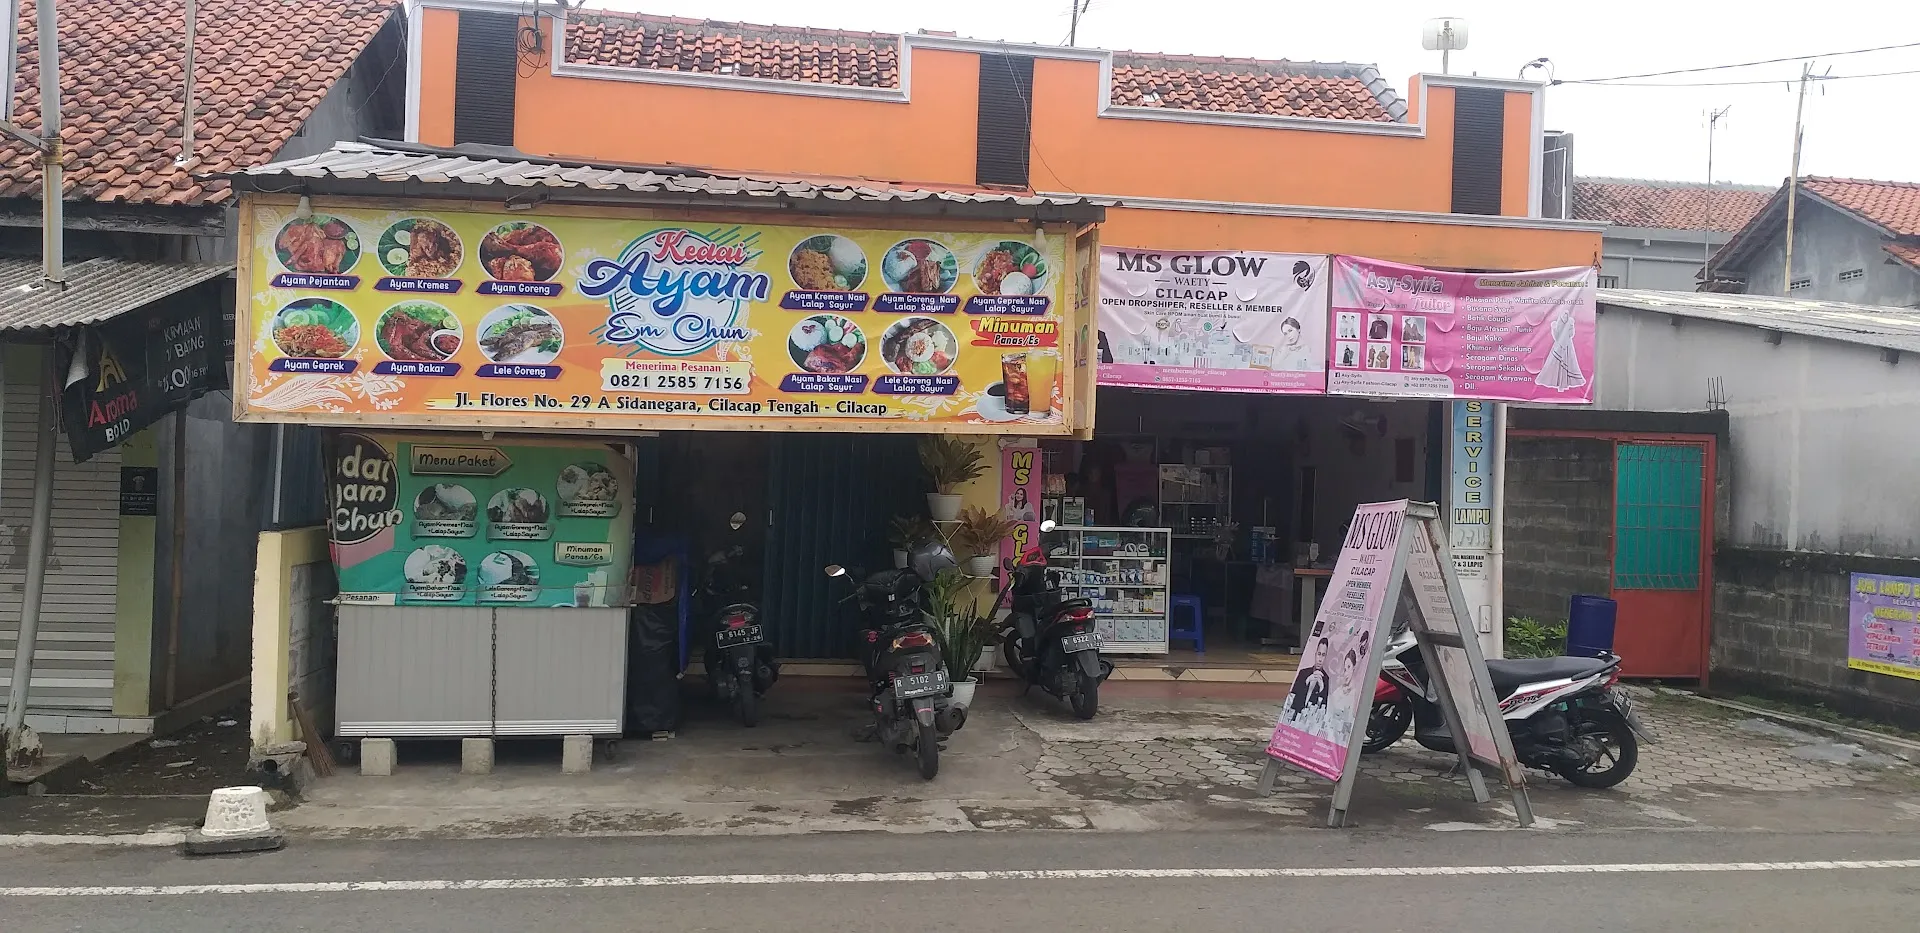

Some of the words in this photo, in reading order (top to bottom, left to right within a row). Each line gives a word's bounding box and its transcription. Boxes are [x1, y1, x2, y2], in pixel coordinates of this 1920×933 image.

[652, 230, 747, 265] Kedai
[1116, 252, 1162, 273] MS
[1170, 255, 1267, 277] GLOW
[280, 275, 307, 287] Ayam
[309, 276, 350, 288] Pejantan
[390, 279, 413, 290] Ayam
[415, 279, 449, 290] Kremes
[578, 251, 769, 317] Ayam
[1175, 277, 1210, 287] WAETY
[1366, 272, 1443, 295] Asy-Syifa
[491, 283, 517, 294] Ayam
[518, 283, 550, 295] Goreng
[1155, 288, 1228, 301] CILACAP
[789, 292, 813, 302] Ayam
[815, 292, 843, 301] Kremes
[848, 293, 865, 301] Nasi
[882, 295, 904, 305] Ayam
[905, 295, 935, 306] Goreng
[939, 296, 956, 304] Nasi
[973, 297, 995, 307] Ayam
[996, 297, 1026, 307] Geprek
[1029, 298, 1045, 306] Nasi
[802, 300, 824, 311] Lalap
[829, 300, 853, 311] Sayur
[894, 302, 916, 313] Lalap
[921, 303, 945, 313] Sayur
[985, 304, 1006, 315] Lalap
[1011, 305, 1034, 315] Sayur
[1102, 298, 1127, 307] OPEN
[1128, 299, 1187, 310] DROPSHIPER,
[1189, 302, 1234, 311] RESELLER
[1245, 305, 1282, 313] MEMBER
[1488, 315, 1511, 323] Couple
[605, 312, 664, 342] Em
[673, 314, 748, 343] Chun
[978, 317, 1055, 334] Minuman
[993, 335, 1039, 347] Panas/Es
[1466, 334, 1482, 342] Baju
[1498, 345, 1532, 353] Kerudung
[1466, 353, 1497, 362] Seragam
[1498, 354, 1518, 362] Dinas
[284, 360, 310, 371] Ayam
[312, 361, 344, 372] Geprek
[391, 363, 417, 374] Ayam
[419, 364, 445, 374] Bakar
[493, 366, 512, 375] Lele
[514, 366, 546, 377] Goreng
[625, 361, 677, 371] Menerima
[681, 362, 721, 373] Pesanan
[1466, 363, 1497, 372] Seragam
[1498, 364, 1526, 372] Sekolah
[610, 375, 649, 387] 0821
[658, 375, 696, 388] 2585
[704, 377, 743, 389] 7156
[791, 374, 815, 385] Ayam
[816, 375, 841, 384] Bakar
[845, 376, 862, 384] Nasi
[884, 376, 902, 385] Lele
[902, 376, 933, 387] Goreng
[936, 377, 953, 385] Nasi
[1465, 373, 1496, 381] Seragam
[1497, 374, 1532, 383] Karyawan
[801, 383, 824, 393] Lalap
[829, 383, 853, 393] Sayur
[893, 384, 916, 394] Lalap
[921, 385, 944, 395] Sayur
[89, 390, 138, 428] Aroma
[455, 393, 473, 407] Jl.
[481, 393, 527, 407] Flores
[534, 394, 563, 407] No.
[571, 396, 591, 408] 29
[597, 397, 610, 409] A
[617, 396, 701, 412] Sidanegara,
[709, 399, 761, 413] Cilacap
[767, 400, 819, 415] Tengah
[837, 401, 887, 416] Cilacap
[106, 419, 130, 442] BOLD
[1464, 401, 1482, 503] SERVICE
[419, 453, 456, 466] Menu
[458, 455, 496, 467] Paket
[1455, 508, 1490, 524] LAMPU
[1345, 513, 1370, 549] MS
[1366, 510, 1405, 550] GLOW
[1351, 567, 1376, 576] CILACAP
[1879, 581, 1911, 598] LAMPU
[897, 679, 902, 687] R
[910, 675, 929, 685] 5102
[937, 673, 943, 681] B
